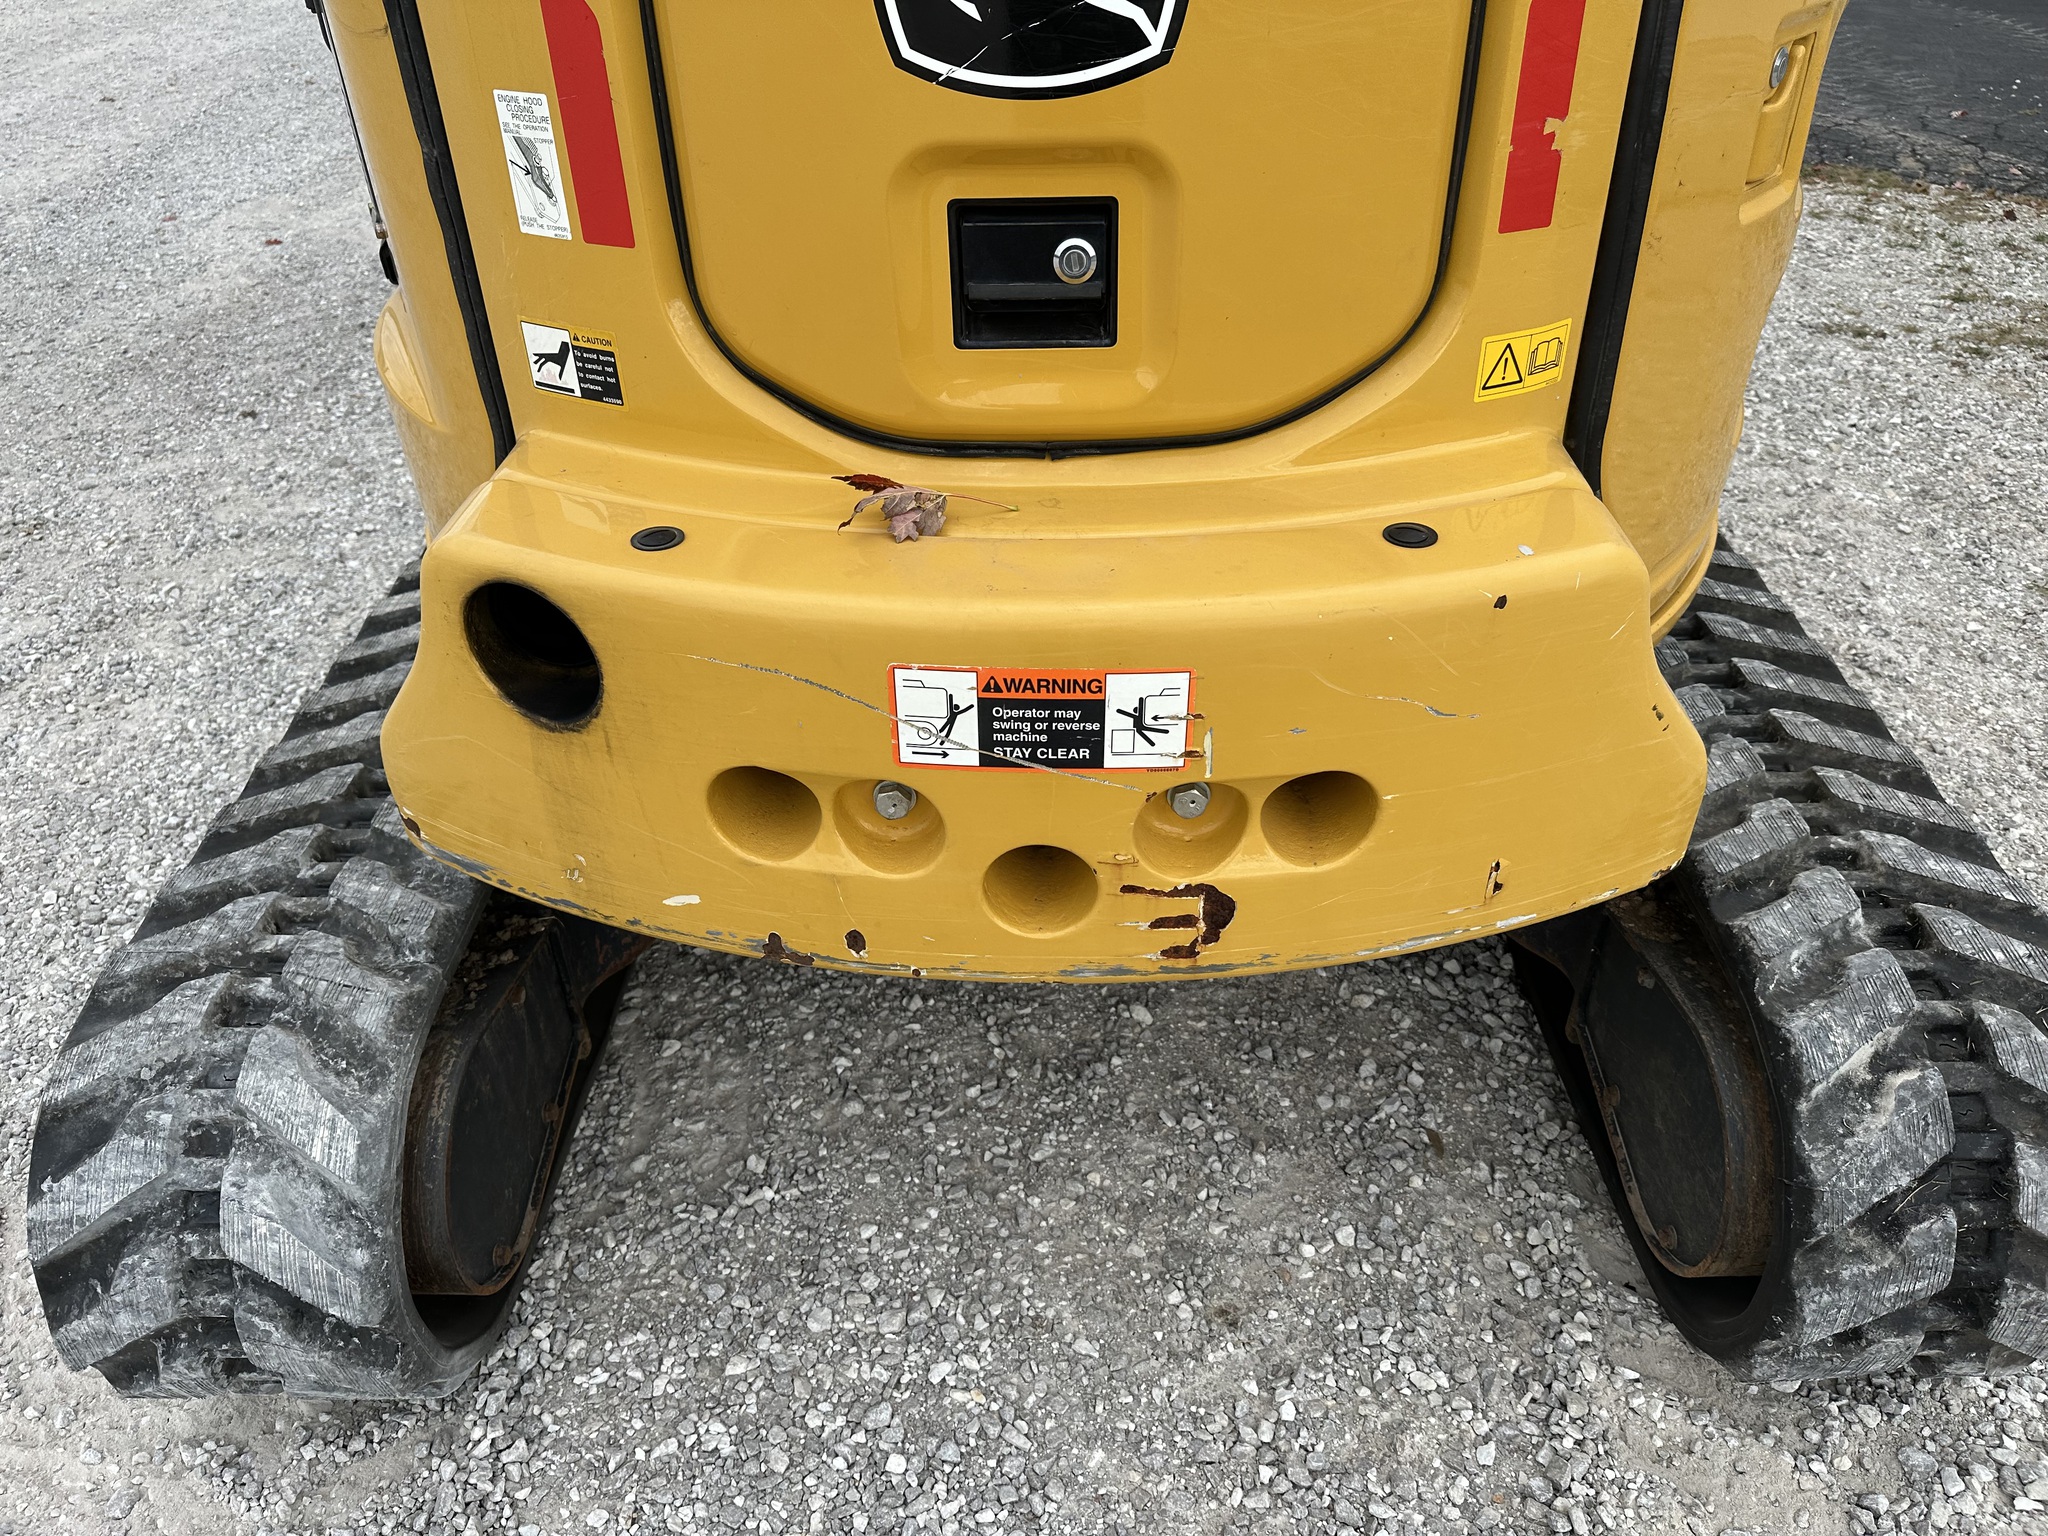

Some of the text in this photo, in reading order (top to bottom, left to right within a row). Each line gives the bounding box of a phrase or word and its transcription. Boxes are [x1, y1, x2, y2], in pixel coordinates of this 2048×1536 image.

[497, 94, 543, 106] ENGINE HOOD
[506, 104, 534, 114] CLOSING
[511, 113, 550, 125] PROCEDURE
[523, 124, 549, 132] OPERATION
[533, 137, 554, 145] STOPPER
[582, 336, 612, 346] CAUTION
[583, 352, 598, 360] avoid
[599, 354, 614, 362] burns
[1003, 678, 1103, 694] WARNING
[992, 706, 1082, 721] Operator may
[992, 720, 1101, 732] swing or reverse
[993, 732, 1048, 742] machine
[993, 746, 1090, 759] STAY CLEAR
